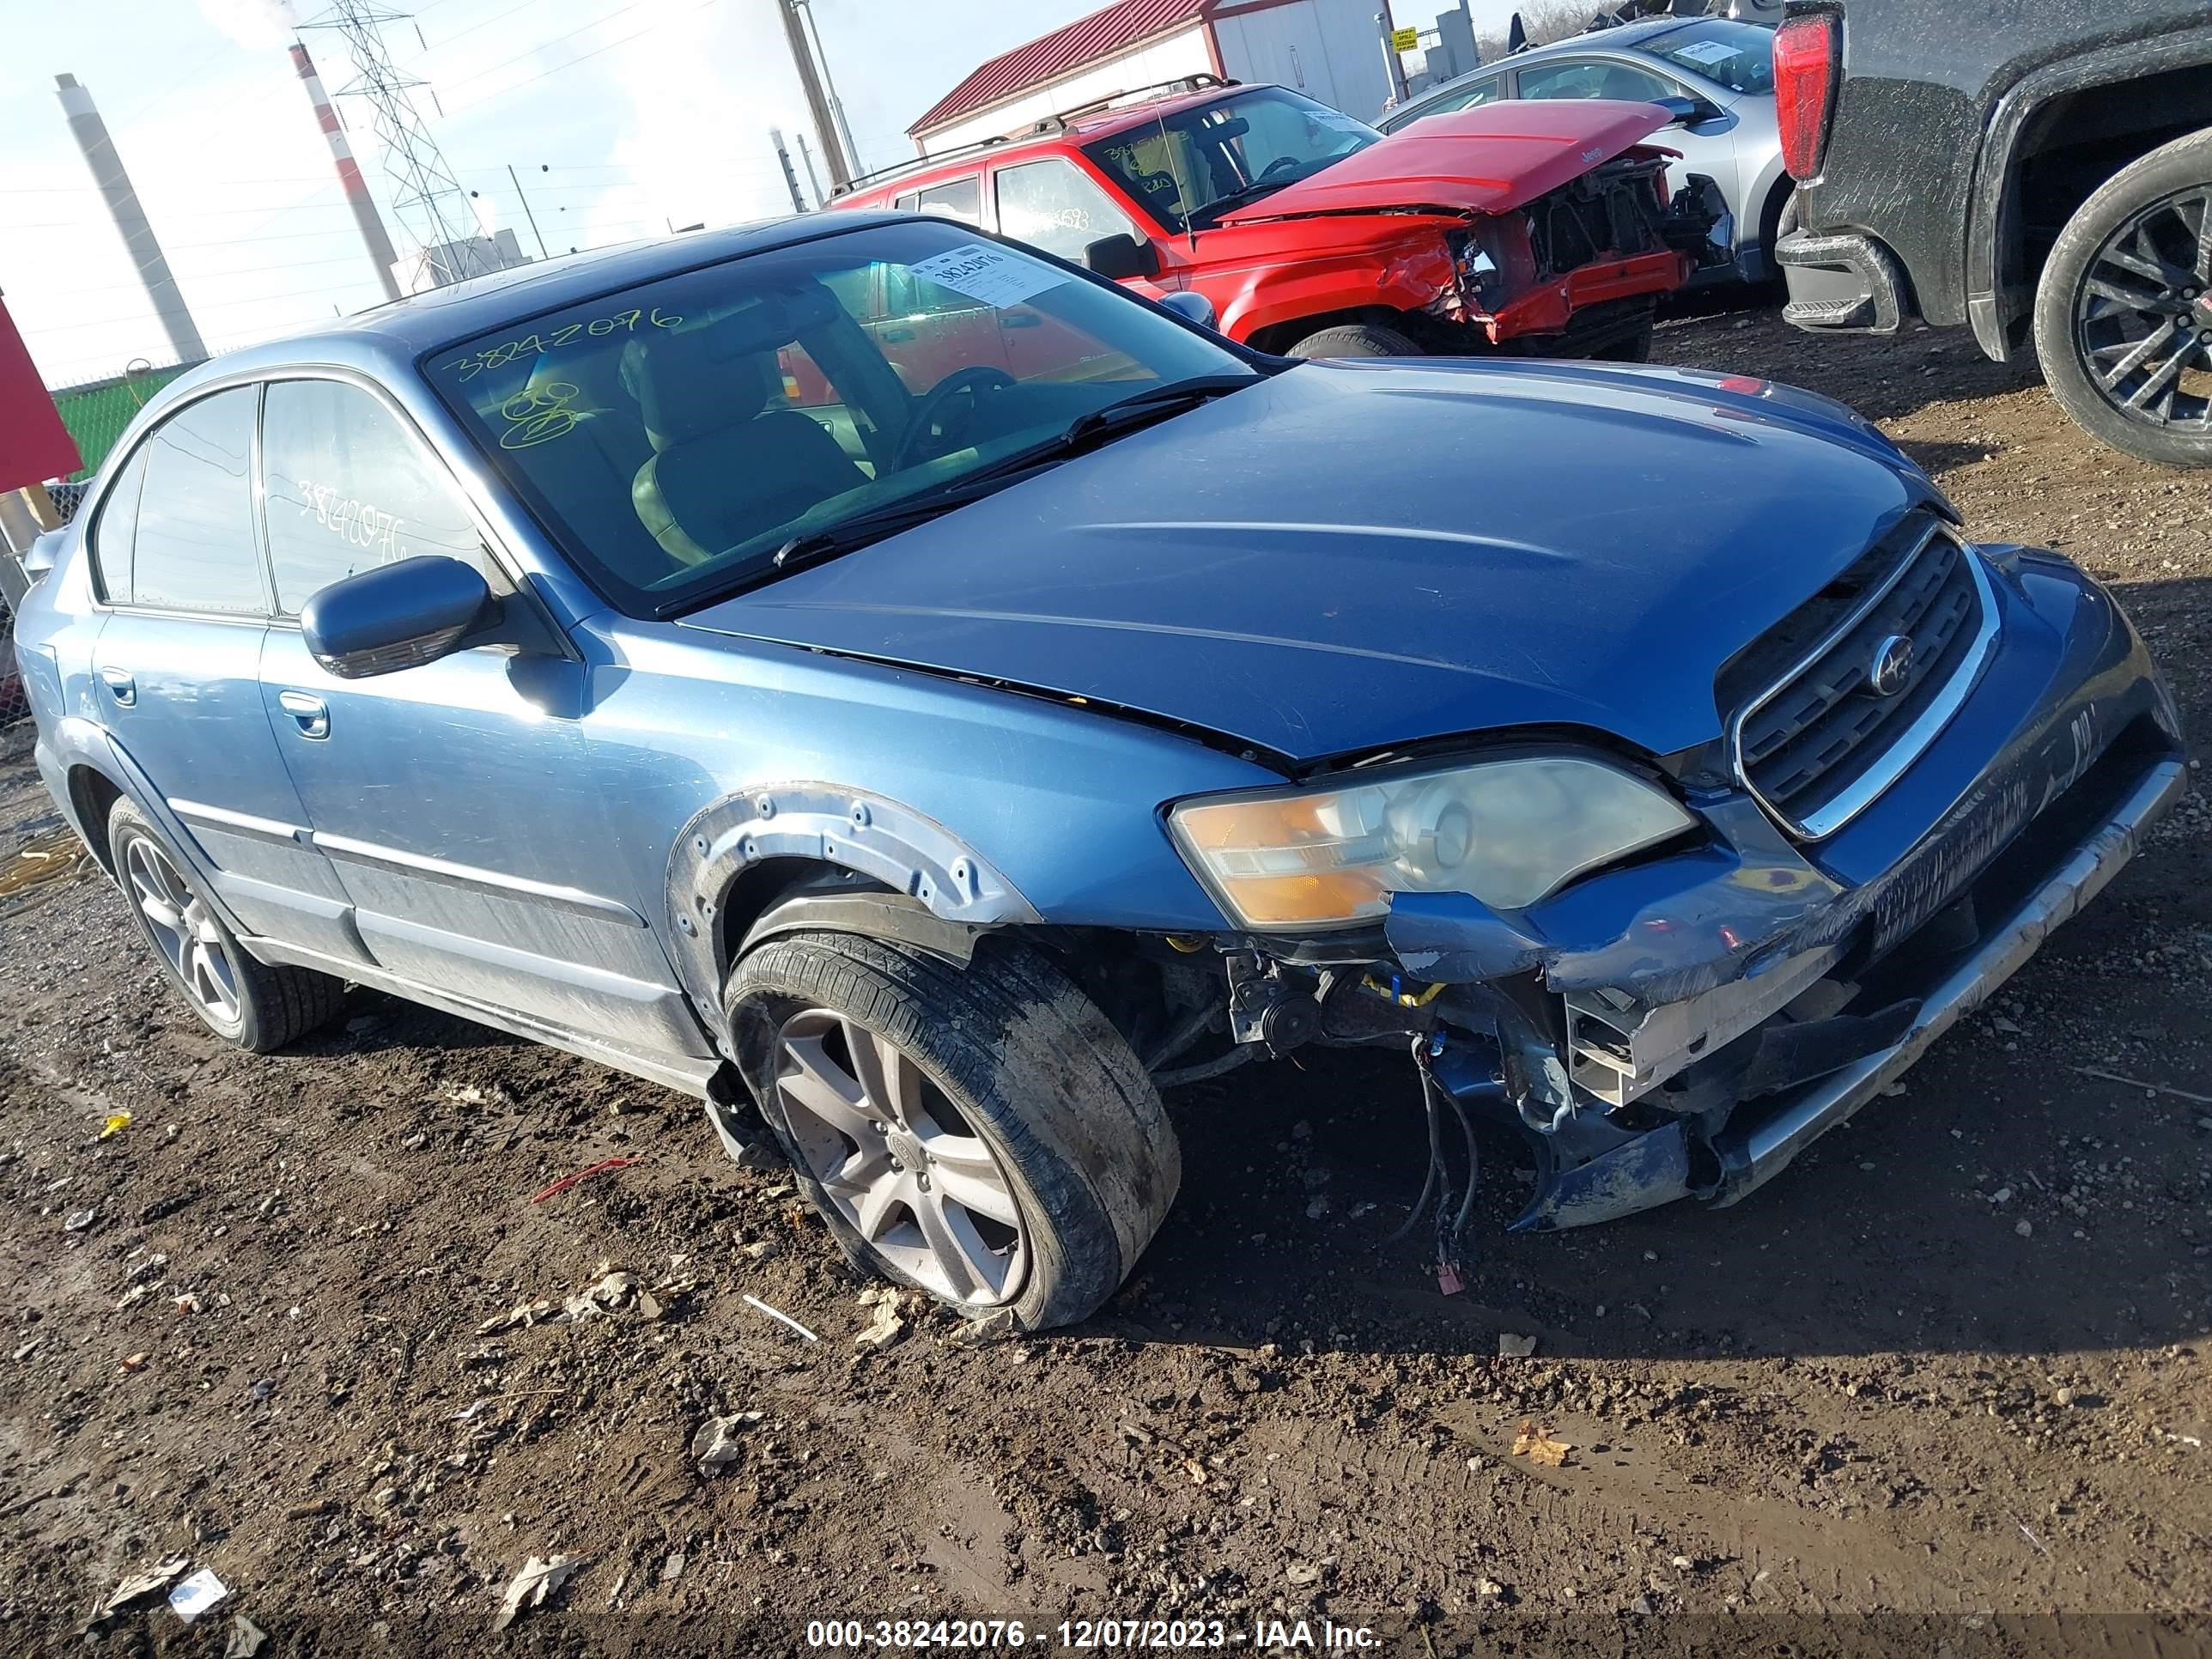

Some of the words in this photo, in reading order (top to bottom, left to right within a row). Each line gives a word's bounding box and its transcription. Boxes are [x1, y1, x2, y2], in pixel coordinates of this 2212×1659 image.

[1581, 148, 1602, 163] Jeep
[934, 253, 1004, 283] 38242076
[441, 307, 684, 383] 38242076
